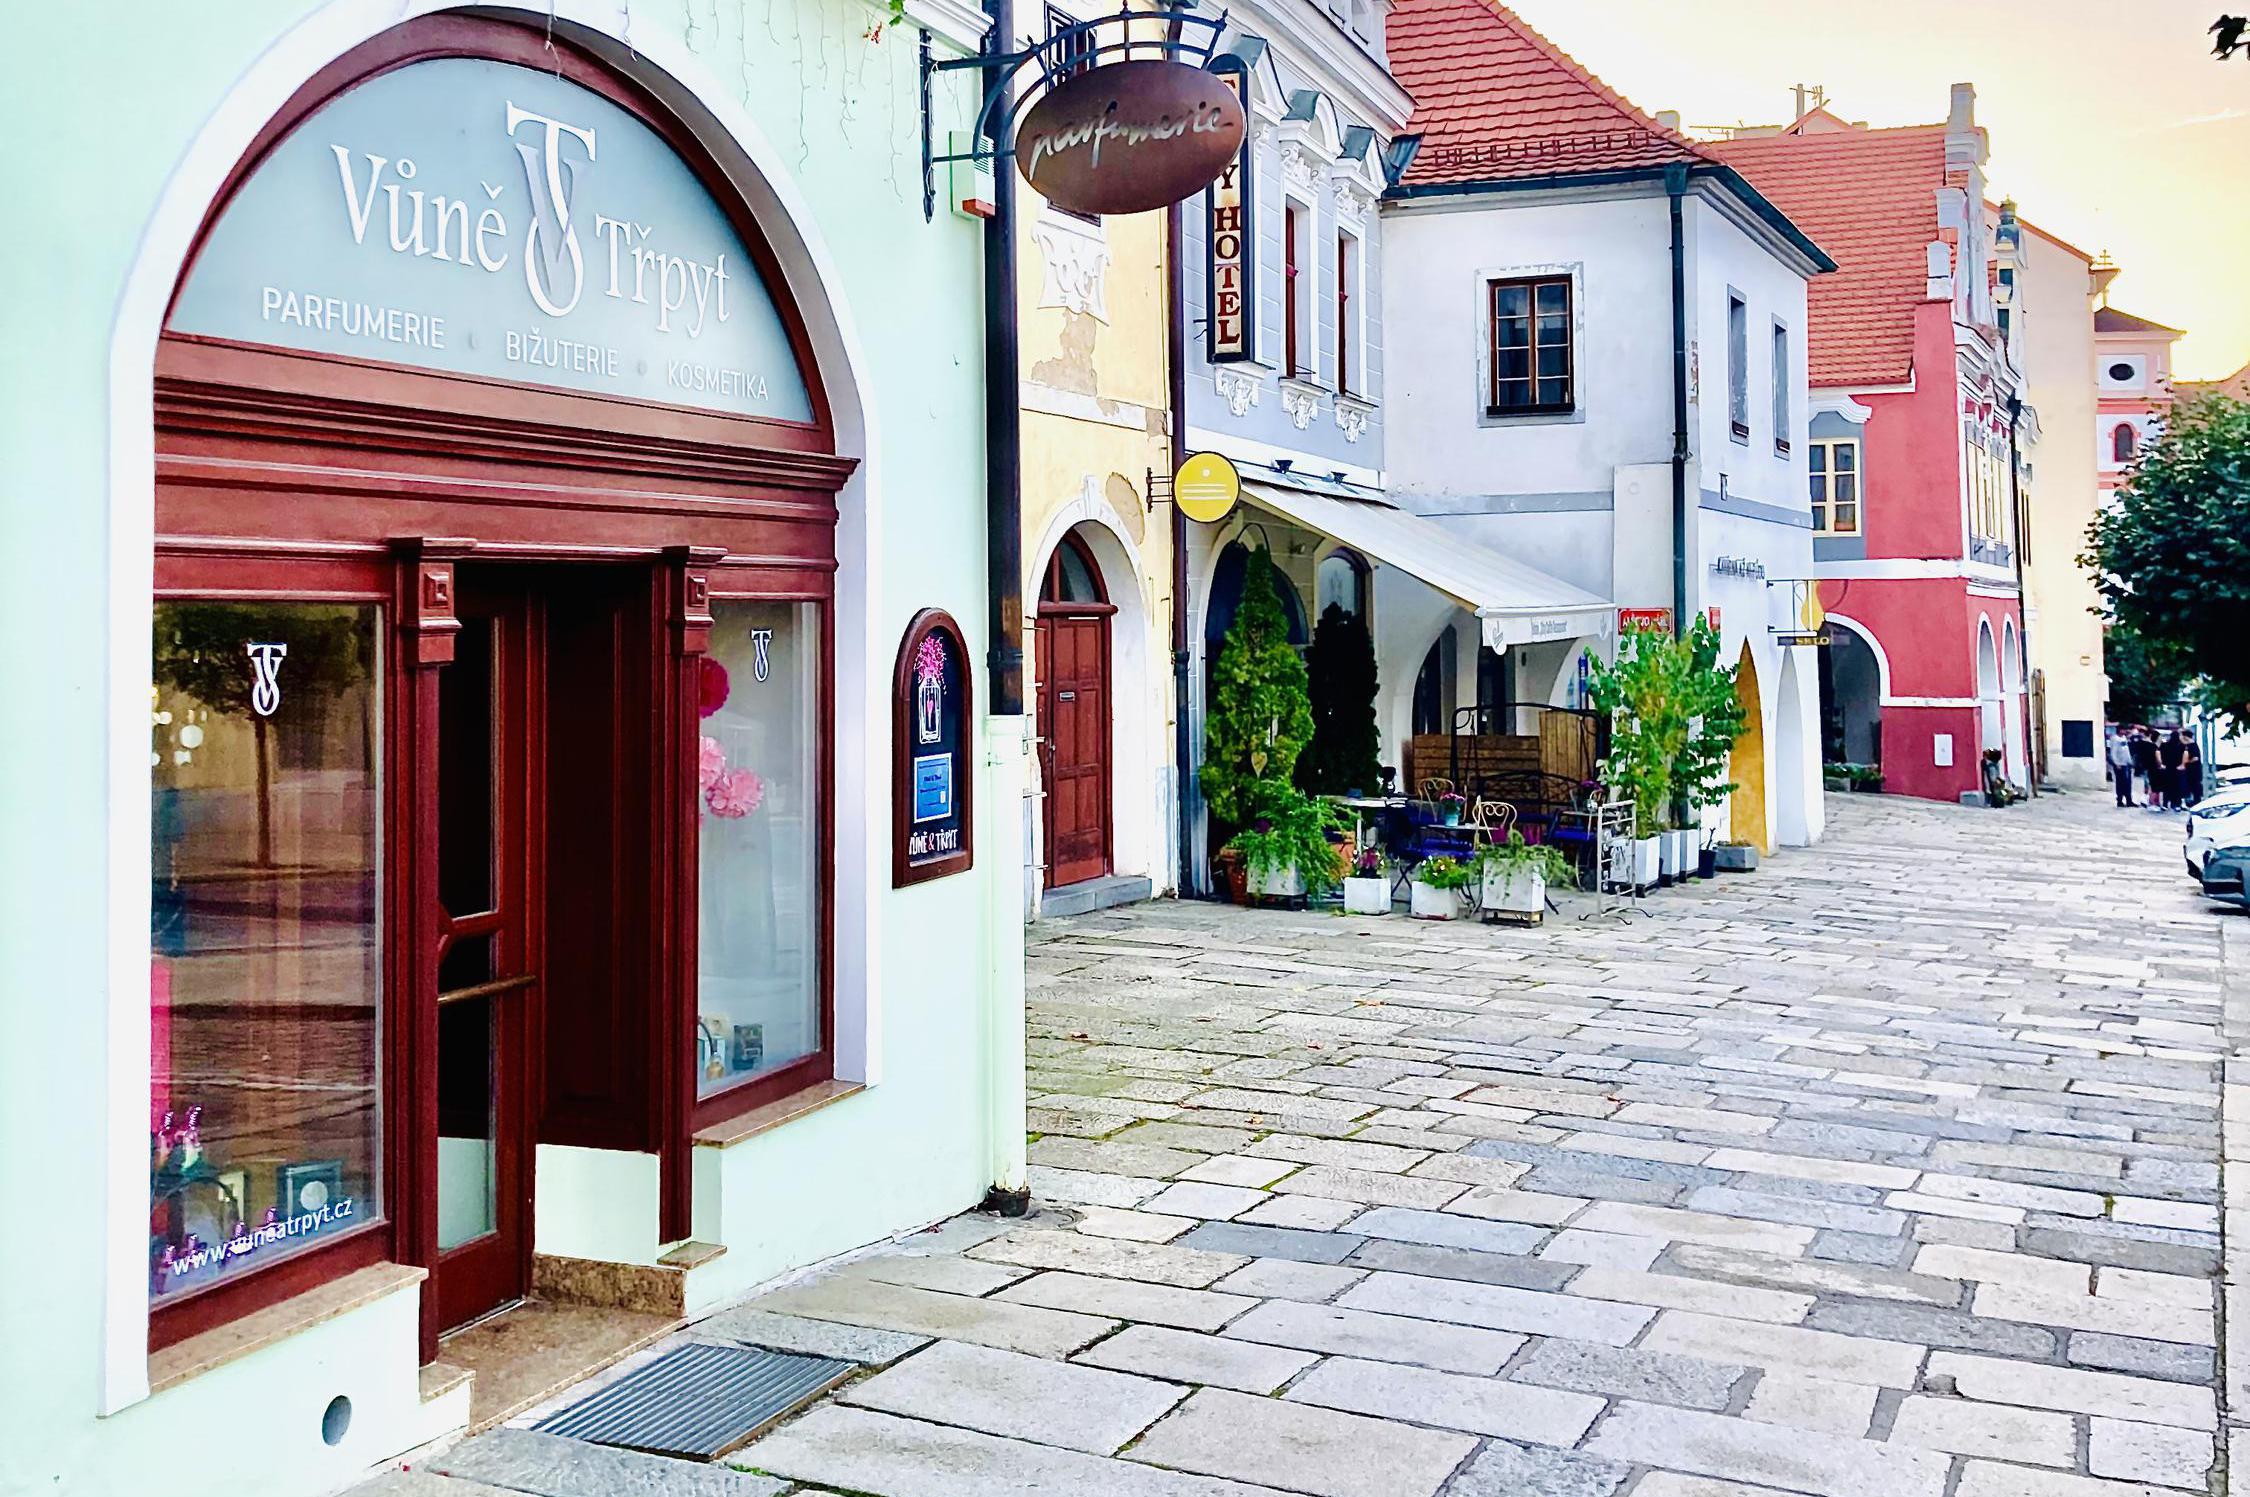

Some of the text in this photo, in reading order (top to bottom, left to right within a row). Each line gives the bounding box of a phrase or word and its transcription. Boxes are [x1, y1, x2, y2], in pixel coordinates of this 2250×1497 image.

[1028, 100, 1234, 181] parfumerie
[330, 144, 731, 338] Vůně Třpyt
[1214, 206, 1241, 345] HOTEL
[262, 286, 769, 400] PARFUMERIE BIŽUTERIE KOSMETIKA
